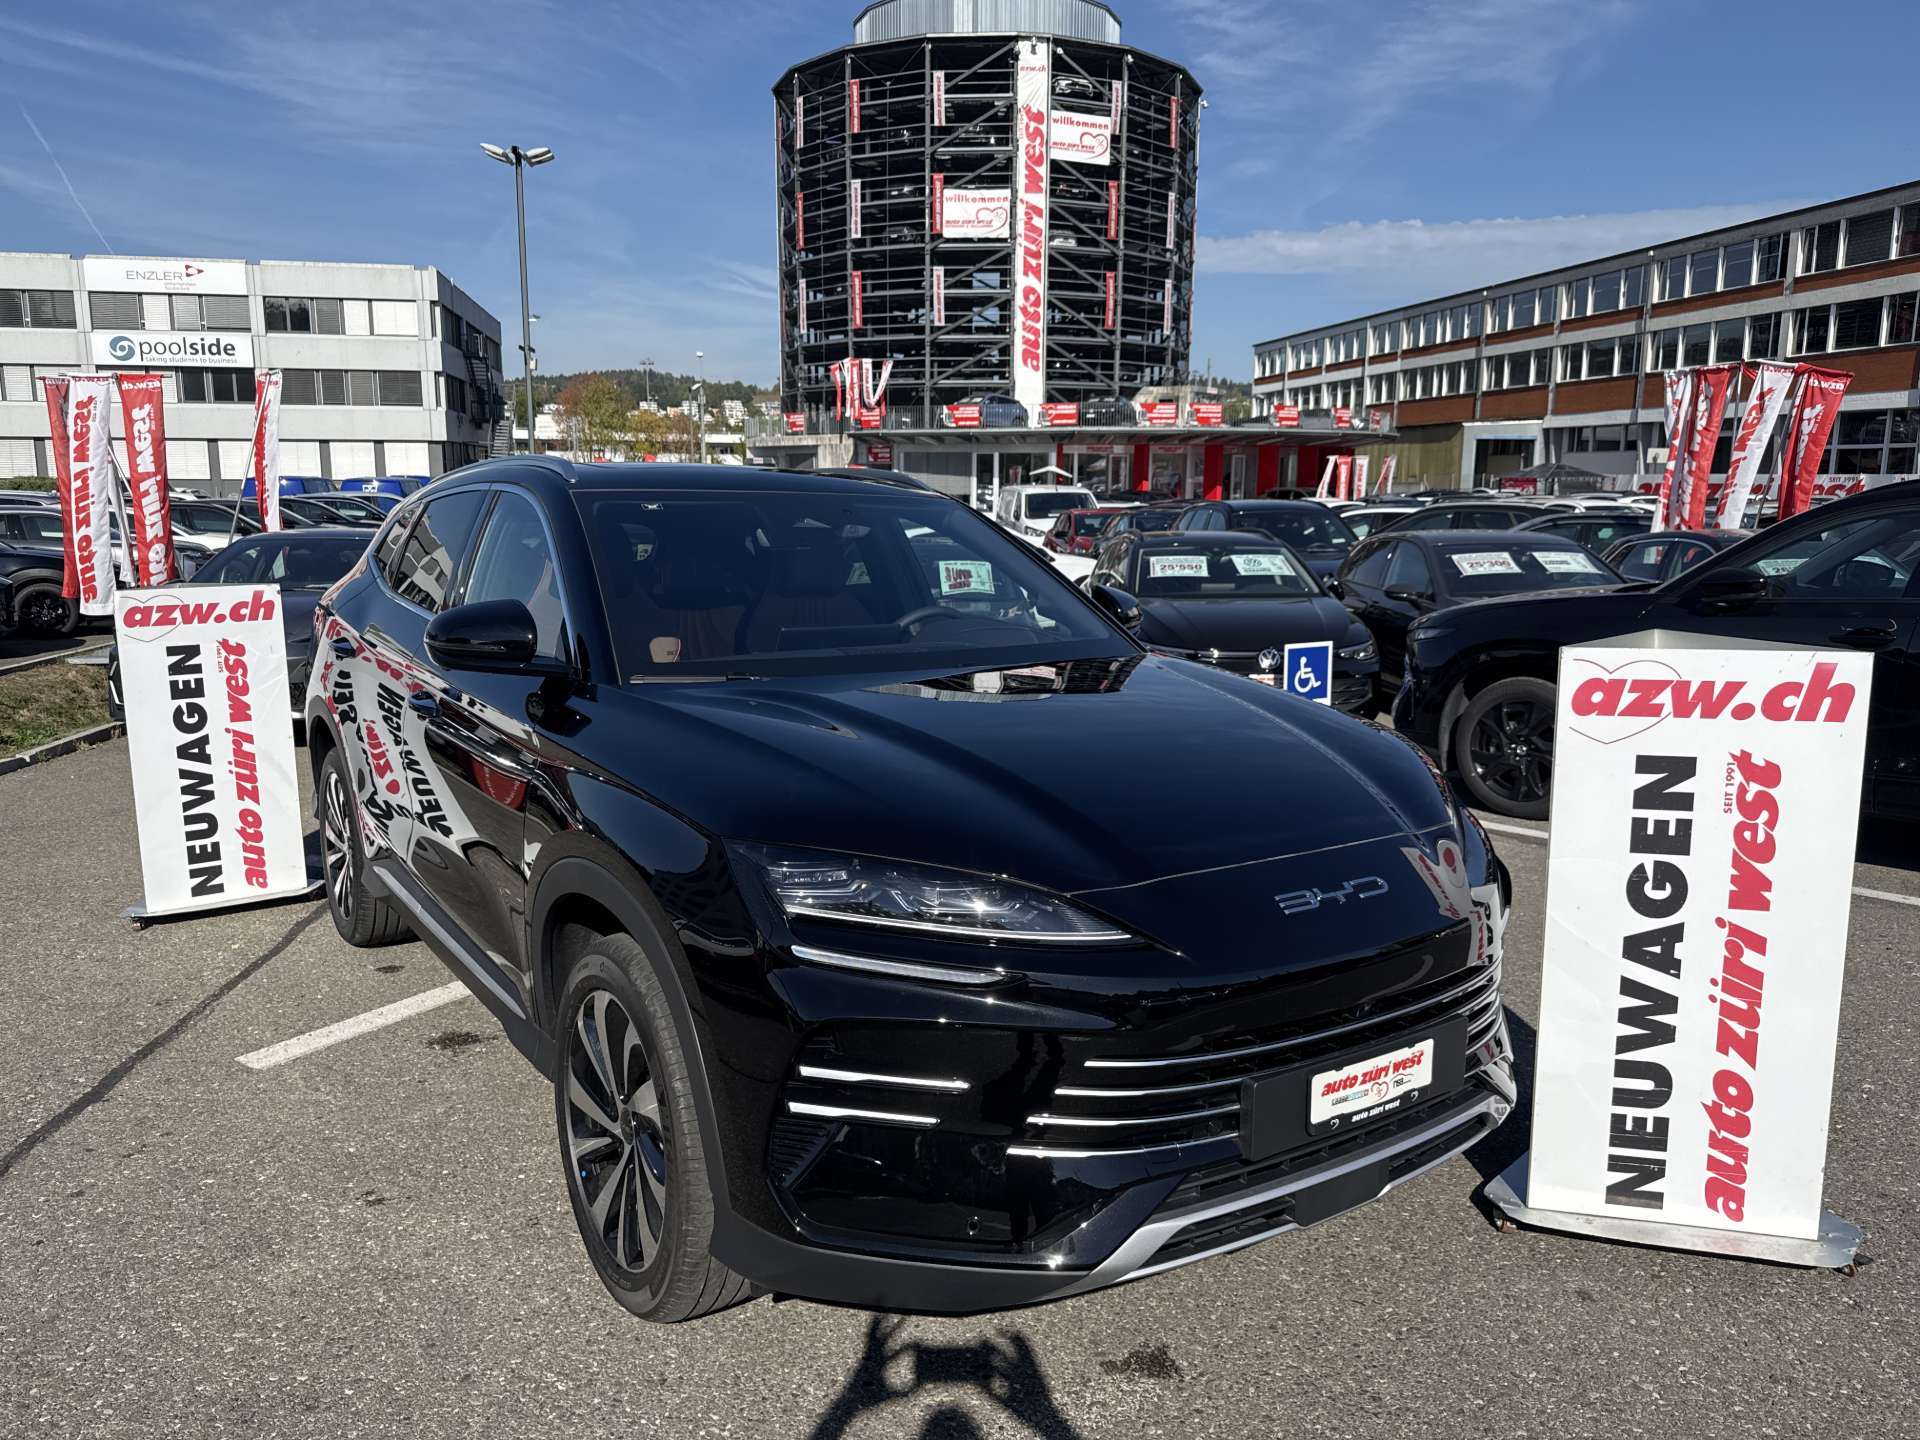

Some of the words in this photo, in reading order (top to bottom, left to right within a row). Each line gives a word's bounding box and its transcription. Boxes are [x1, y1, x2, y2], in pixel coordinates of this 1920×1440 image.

[1019, 104, 1045, 194] west
[1052, 115, 1109, 130] willkommen
[945, 194, 1008, 204] willkommen
[1019, 197, 1044, 283] züri
[126, 270, 183, 281] ENZLER
[138, 337, 236, 362] poolside
[1018, 285, 1041, 372] auto
[145, 356, 168, 364] taking
[169, 356, 199, 364] students
[199, 357, 207, 365] to
[208, 357, 238, 365] business
[1159, 563, 1203, 572] 25'550
[123, 590, 276, 628] azw.ch
[219, 638, 253, 724] west
[1570, 661, 1857, 723] azw.ch
[165, 643, 225, 898] NEUWAGEN
[224, 727, 261, 807] züri
[1724, 761, 1736, 787] 1991
[1723, 787, 1733, 814] SEIT
[234, 807, 269, 889] auto
[1726, 748, 1782, 913] west
[1272, 875, 1390, 916] BYD
[1604, 753, 1698, 1210] NEUWAGEN
[1707, 915, 1768, 1072] züri
[1321, 1073, 1359, 1097] auto
[1359, 1060, 1392, 1086] züri
[1391, 1050, 1425, 1074] west
[1351, 1108, 1369, 1122] auto
[1369, 1103, 1385, 1117] züri
[1384, 1098, 1401, 1111] west
[1700, 1067, 1754, 1223] auto
